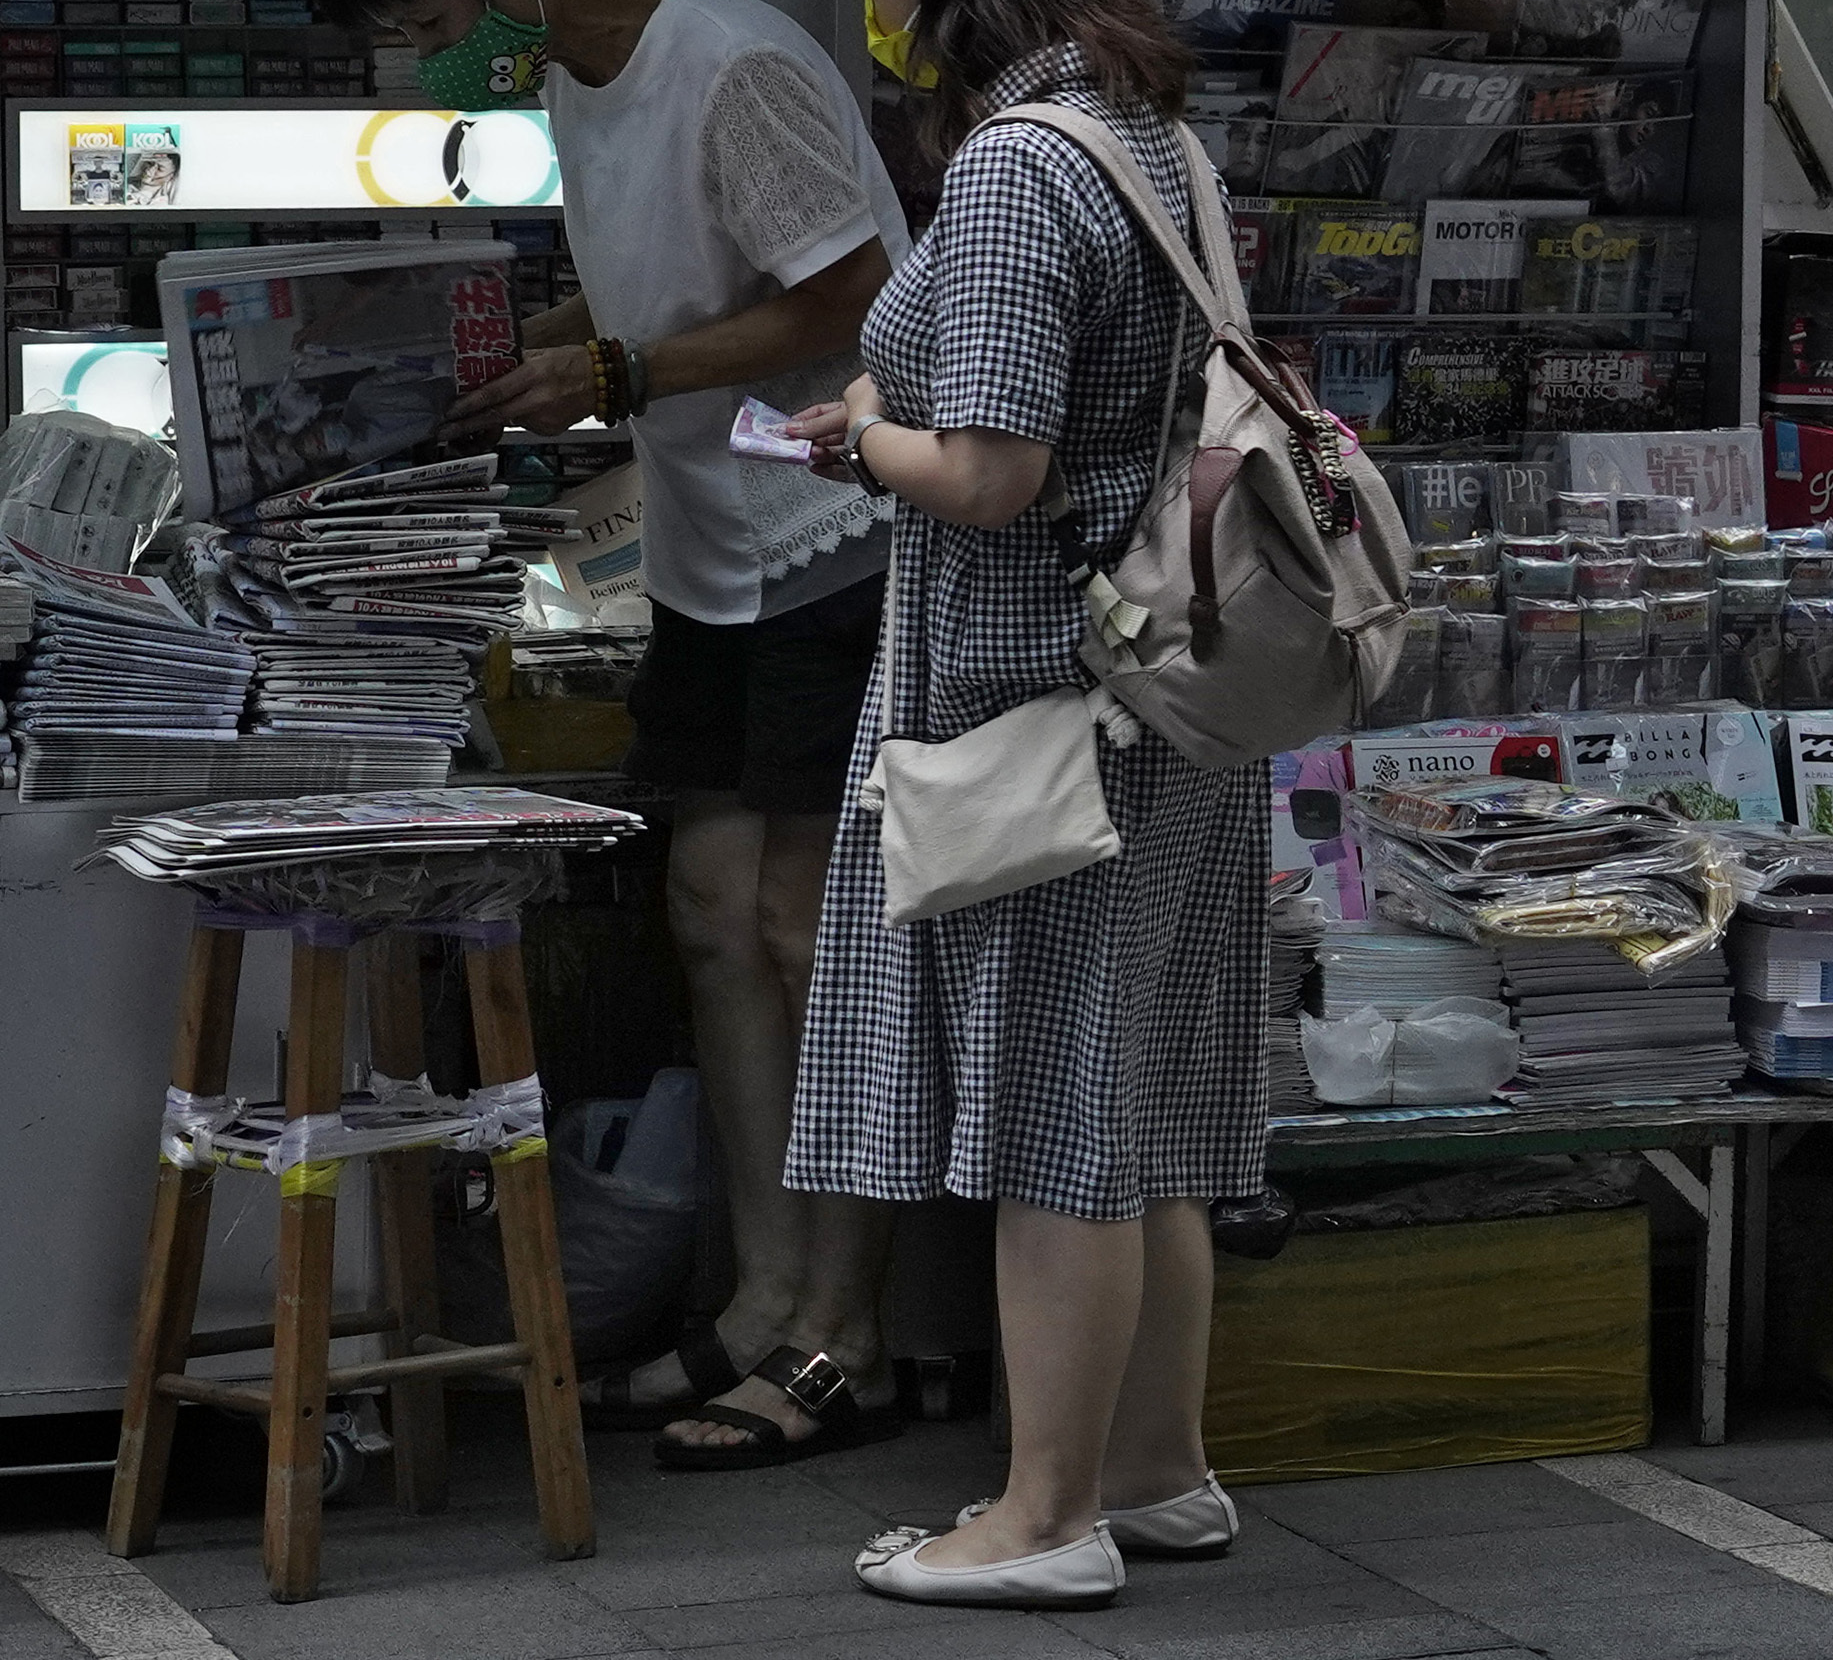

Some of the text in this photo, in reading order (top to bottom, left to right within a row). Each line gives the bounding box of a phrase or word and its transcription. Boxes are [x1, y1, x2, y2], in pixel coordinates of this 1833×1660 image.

[1436, 221, 1514, 241] MOTOR
[590, 578, 639, 600] Beijing
[1624, 730, 1691, 743] BILLA
[1408, 754, 1475, 772] nano
[1630, 748, 1691, 762] BONG
